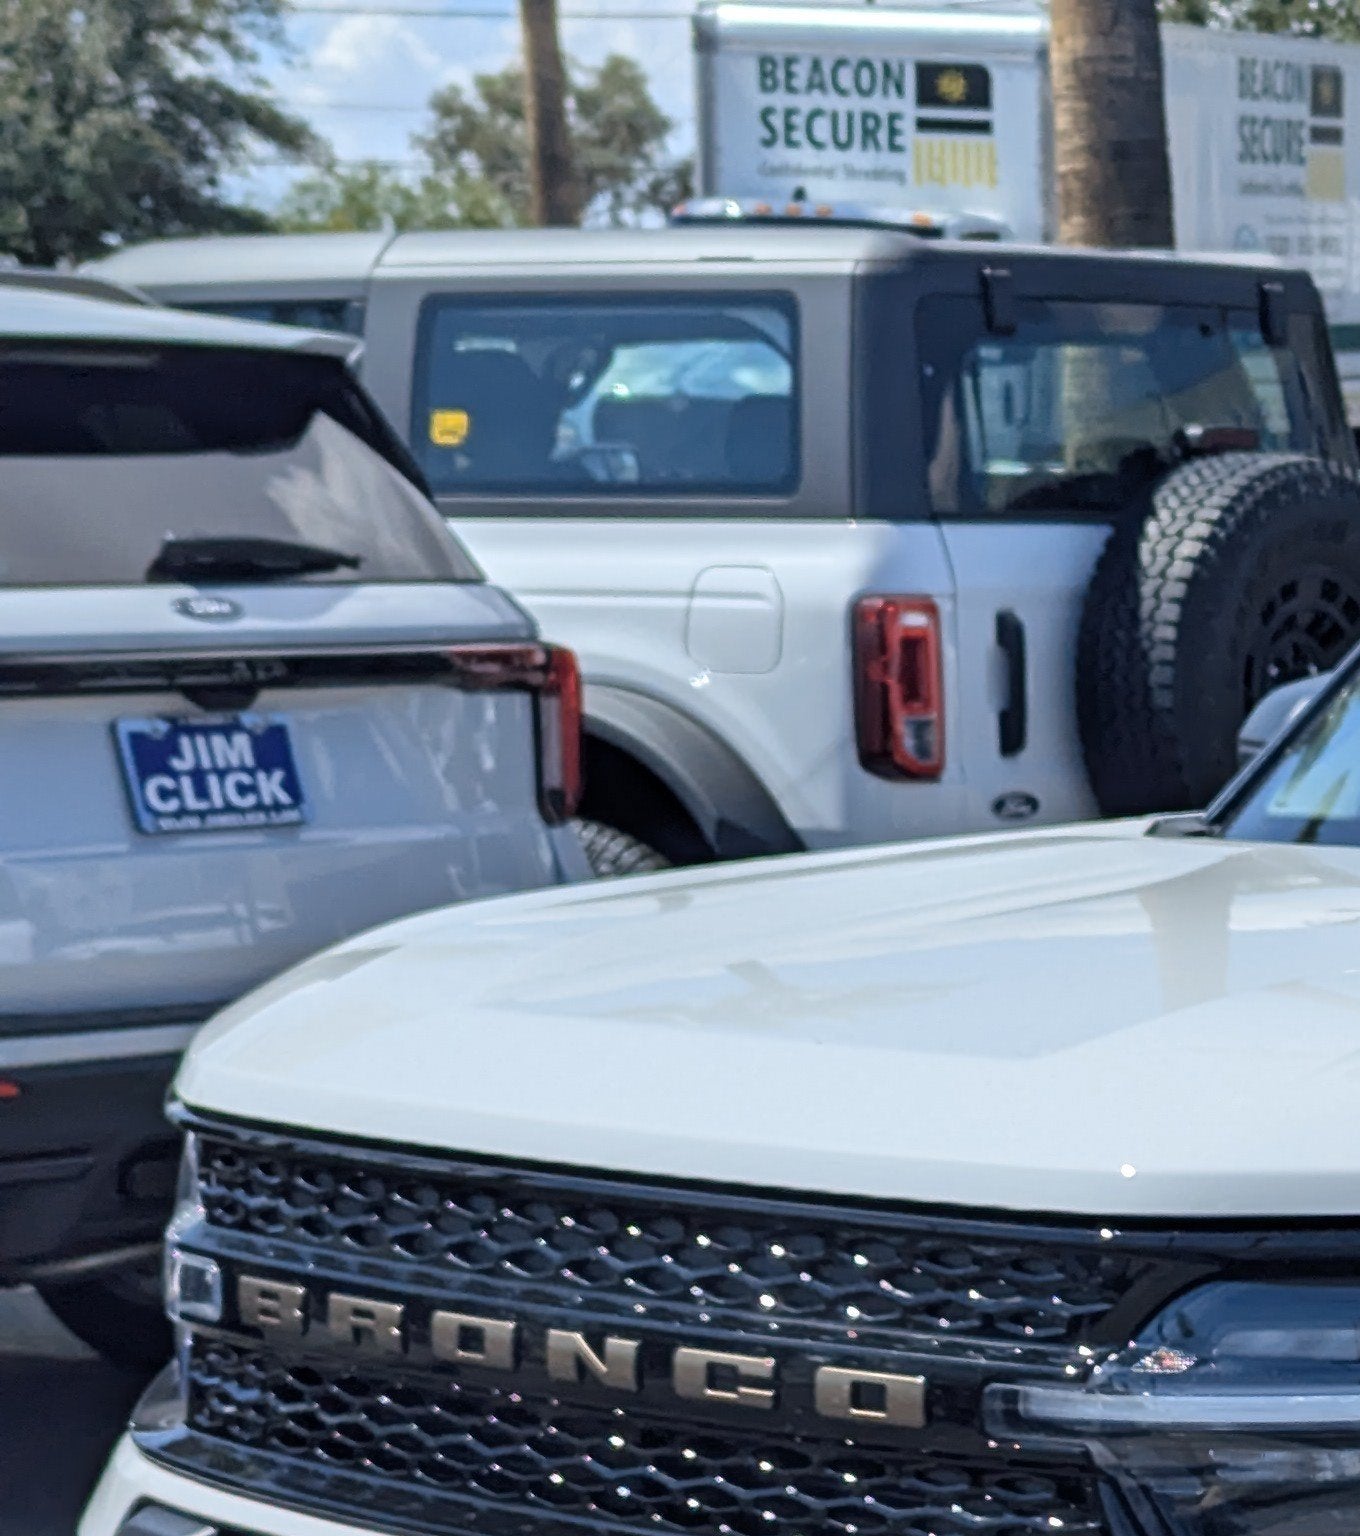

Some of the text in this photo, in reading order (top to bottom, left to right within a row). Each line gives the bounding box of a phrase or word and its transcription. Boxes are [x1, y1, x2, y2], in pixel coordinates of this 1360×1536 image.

[758, 55, 906, 99] BEACON
[1238, 57, 1307, 103] BEACON
[759, 105, 906, 153] SECURE
[1238, 114, 1307, 166] SECURE
[169, 731, 256, 771] JIM
[144, 769, 293, 813] CLICK
[236, 1273, 927, 1429] BRONCO
